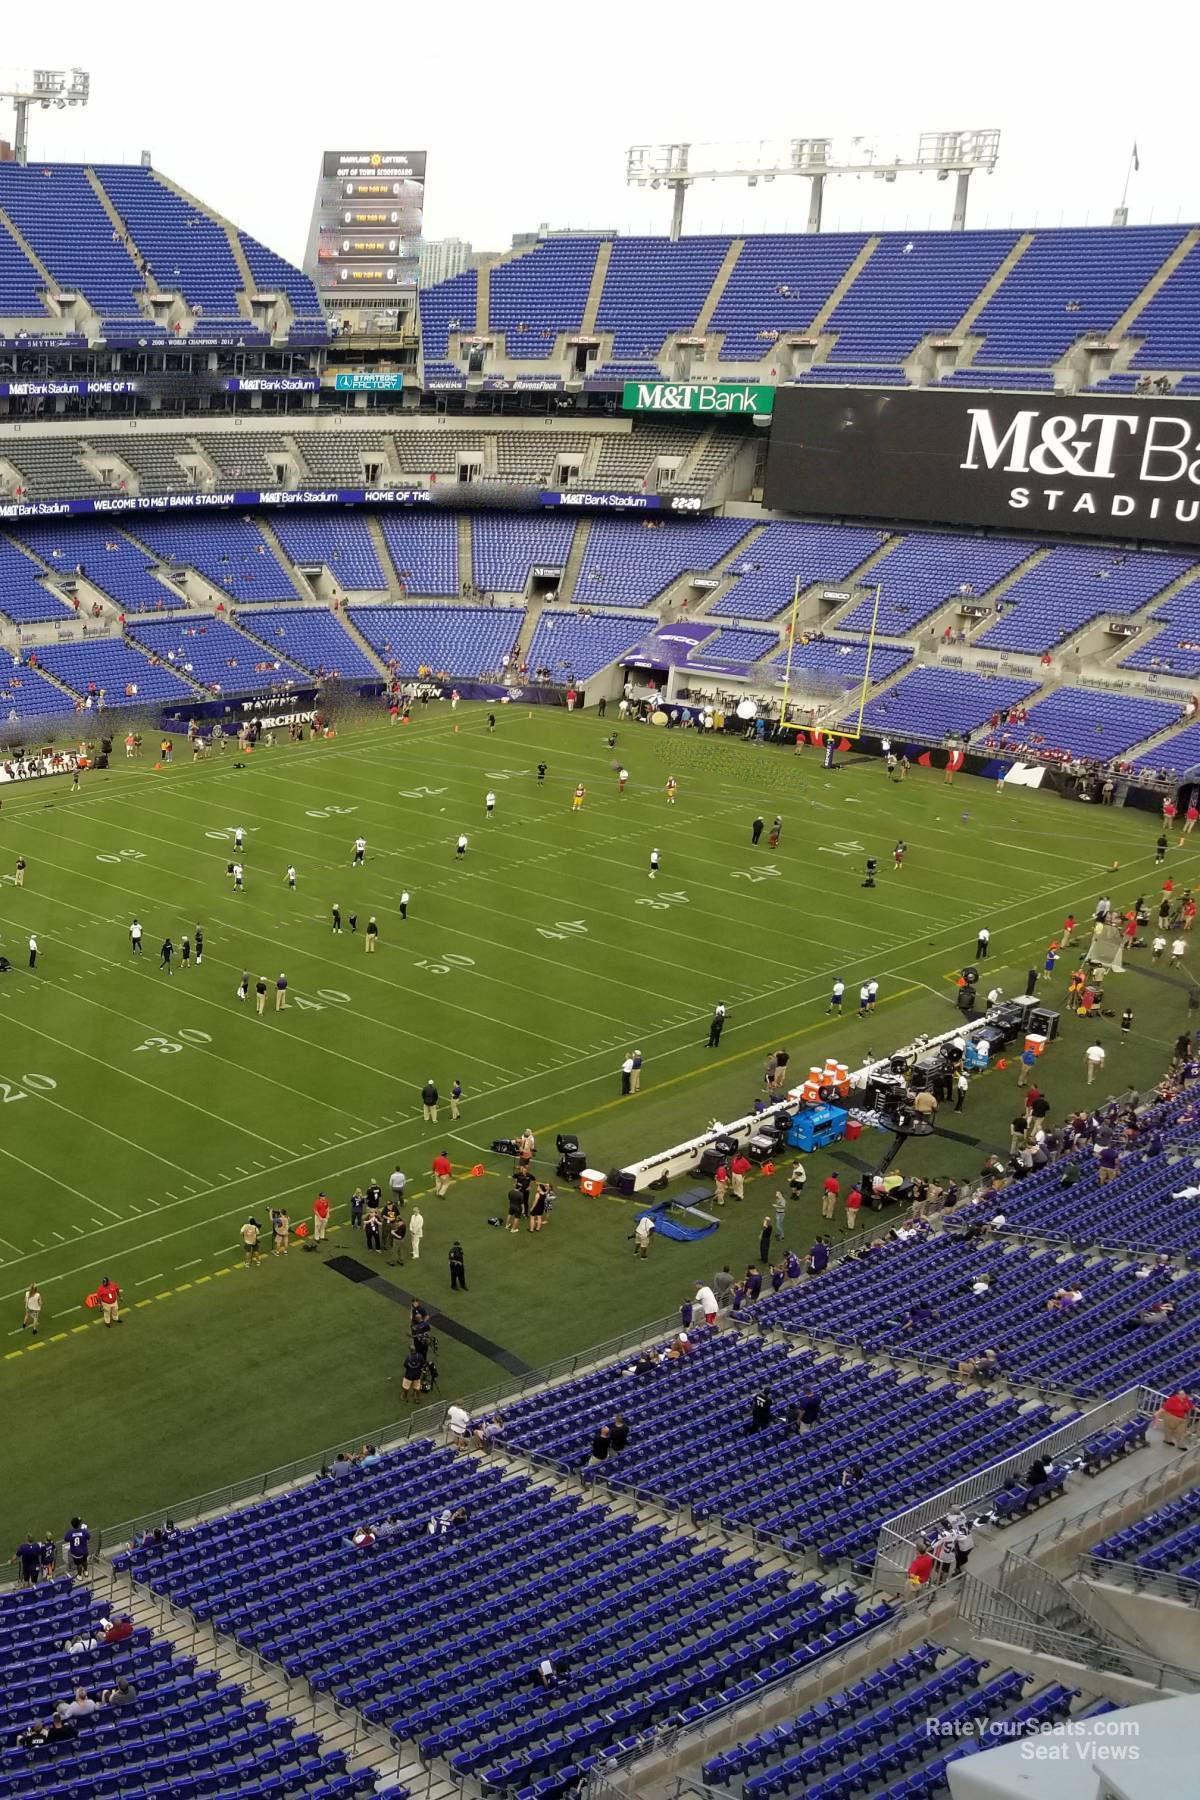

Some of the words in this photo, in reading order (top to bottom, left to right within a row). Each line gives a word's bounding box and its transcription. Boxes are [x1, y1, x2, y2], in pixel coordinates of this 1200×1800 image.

[9, 384, 29, 395] M&T
[29, 384, 48, 394] Bank
[49, 383, 79, 394] Stadium
[88, 382, 111, 393] HOME
[113, 382, 125, 392] OF
[239, 380, 261, 391] M&T
[261, 379, 281, 390] Bank
[282, 379, 315, 390] Stadium
[352, 381, 397, 389] FACTORY
[513, 381, 557, 390] #RavensFlock
[636, 385, 699, 409] M&T
[700, 386, 759, 411] Bank
[960, 408, 1139, 478] M&T
[94, 499, 136, 511] WELCOME
[138, 498, 150, 508] TO
[151, 497, 168, 507] M&T
[170, 496, 193, 506] BANK
[195, 494, 234, 505] STADIUM
[259, 492, 282, 503] M&T
[282, 491, 302, 502] Bank
[303, 491, 338, 502] Stadium
[365, 491, 394, 502] HOME
[396, 491, 409, 502] OF
[412, 491, 430, 501] THE
[560, 493, 585, 505] M&T
[585, 494, 608, 505] Bank
[609, 495, 647, 507] Stadium
[19, 504, 38, 516] Bank
[39, 503, 70, 515] Stadium
[1008, 487, 1200, 522] STADIU
[413, 953, 476, 974] 50
[293, 988, 351, 1011] 40
[144, 1028, 213, 1054] 30
[583, 1180, 593, 1191] G
